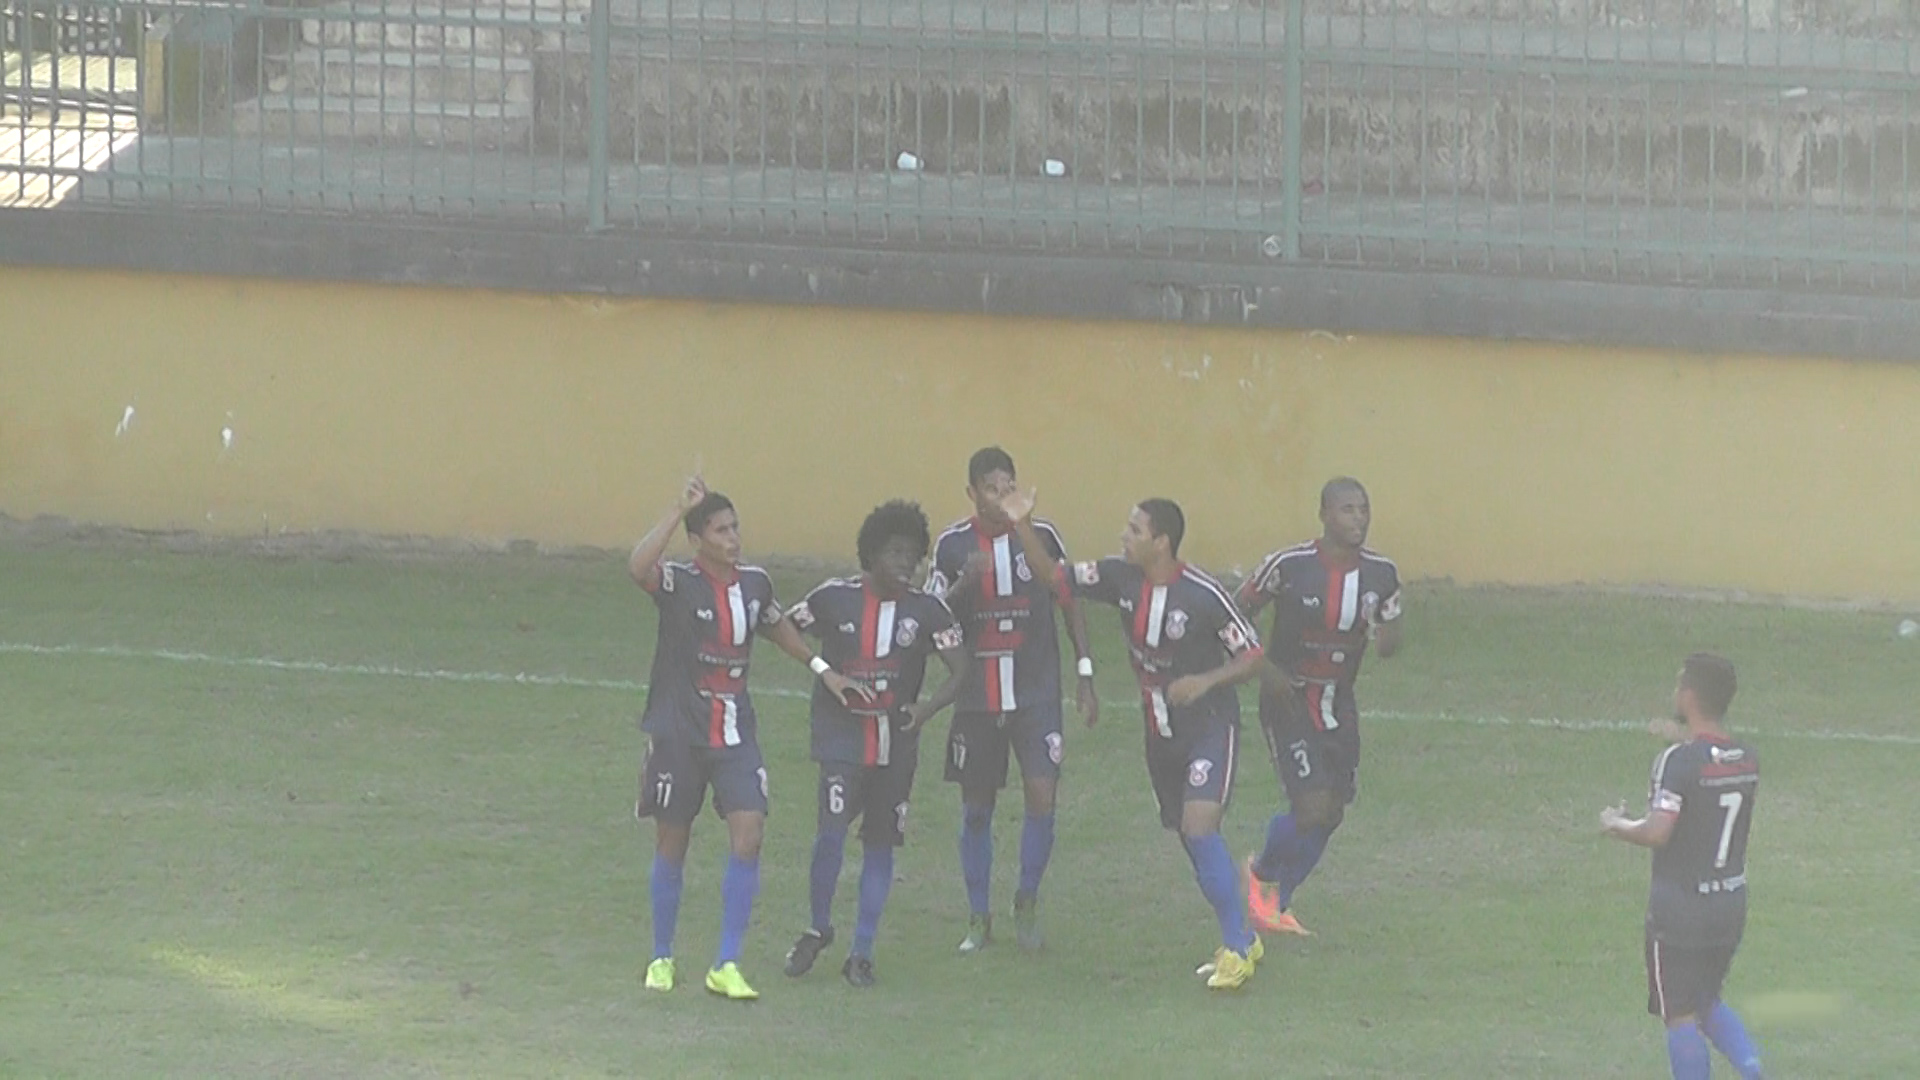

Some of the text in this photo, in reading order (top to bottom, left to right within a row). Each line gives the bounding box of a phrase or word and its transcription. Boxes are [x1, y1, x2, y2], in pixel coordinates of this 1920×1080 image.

[1293, 749, 1311, 778] 3
[829, 784, 844, 814] 6
[1714, 791, 1742, 868] 7
